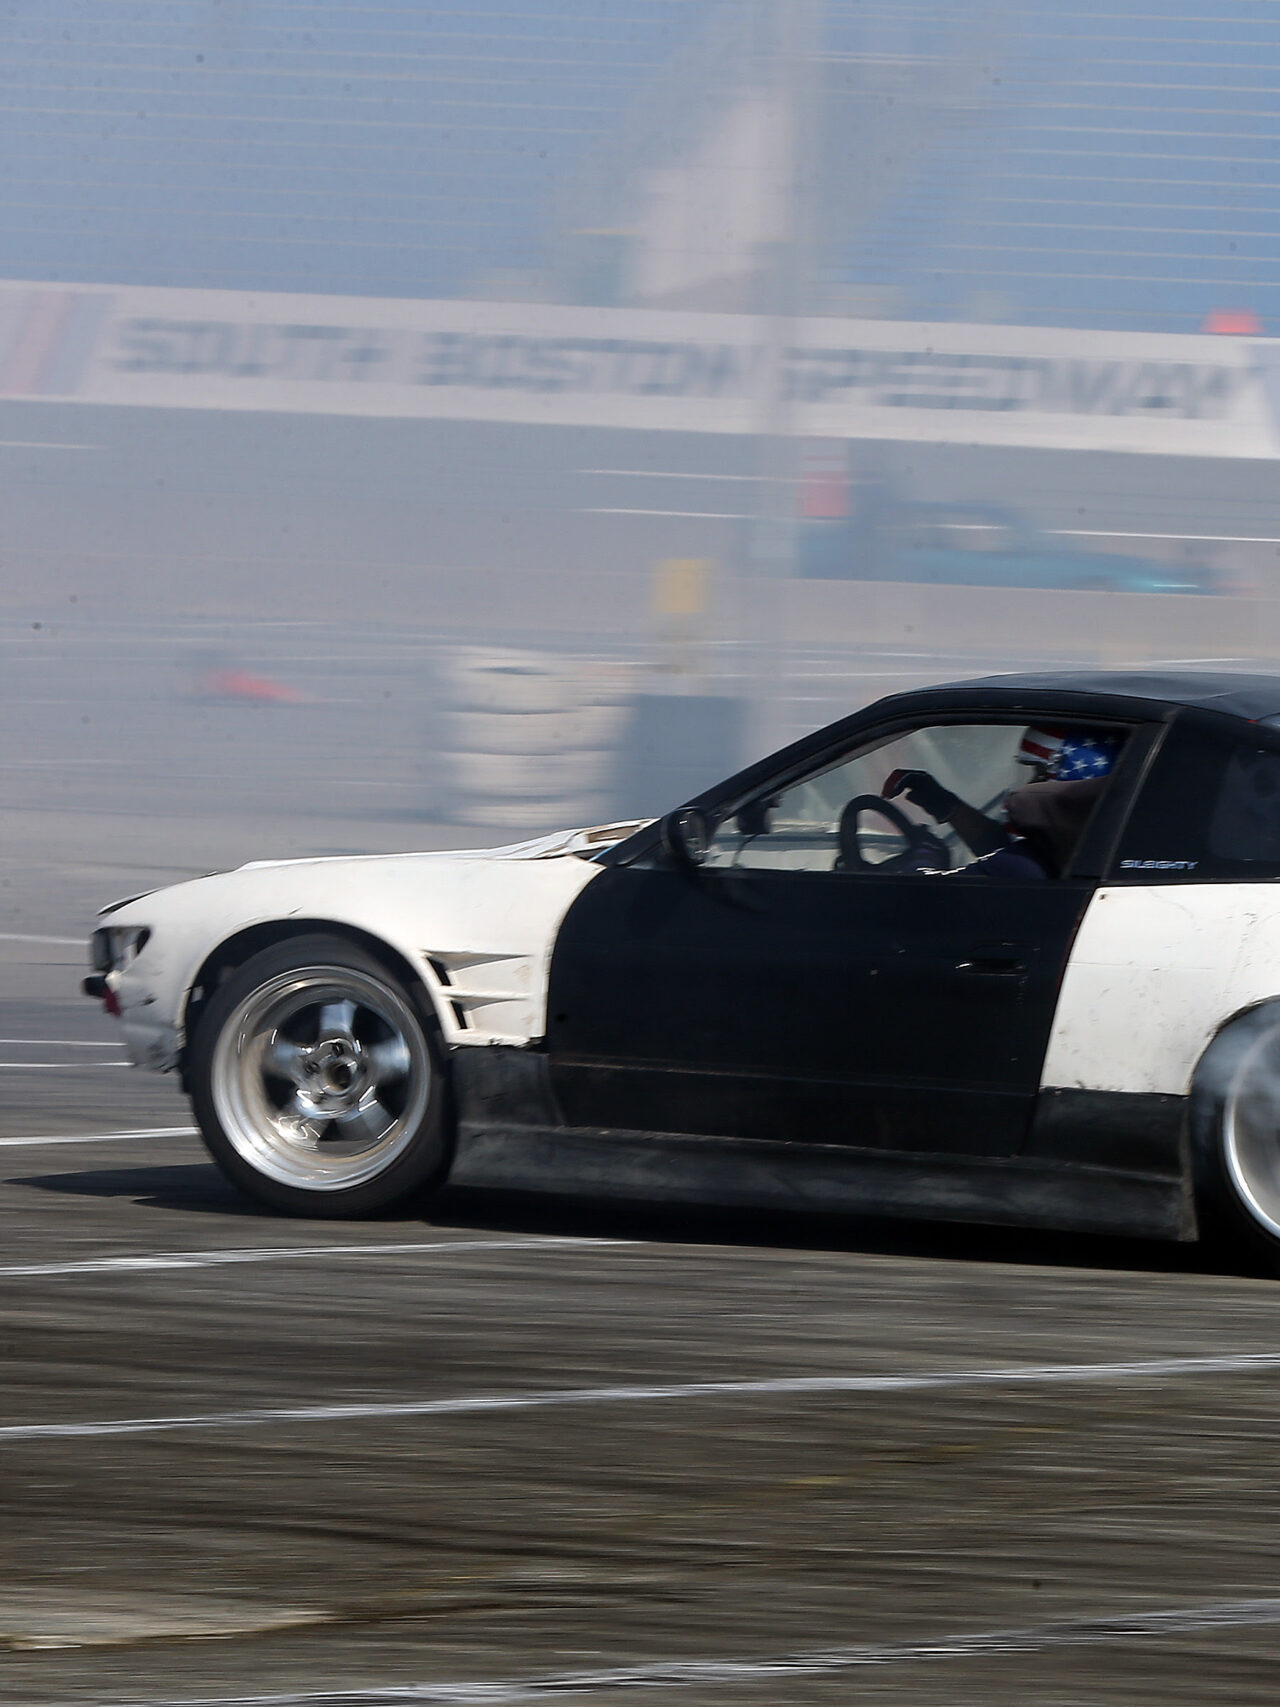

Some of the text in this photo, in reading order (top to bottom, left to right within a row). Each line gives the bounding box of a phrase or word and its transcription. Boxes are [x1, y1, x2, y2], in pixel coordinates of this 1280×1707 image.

[105, 316, 1256, 419] SOUTH BOSTON SPEEDWAY
